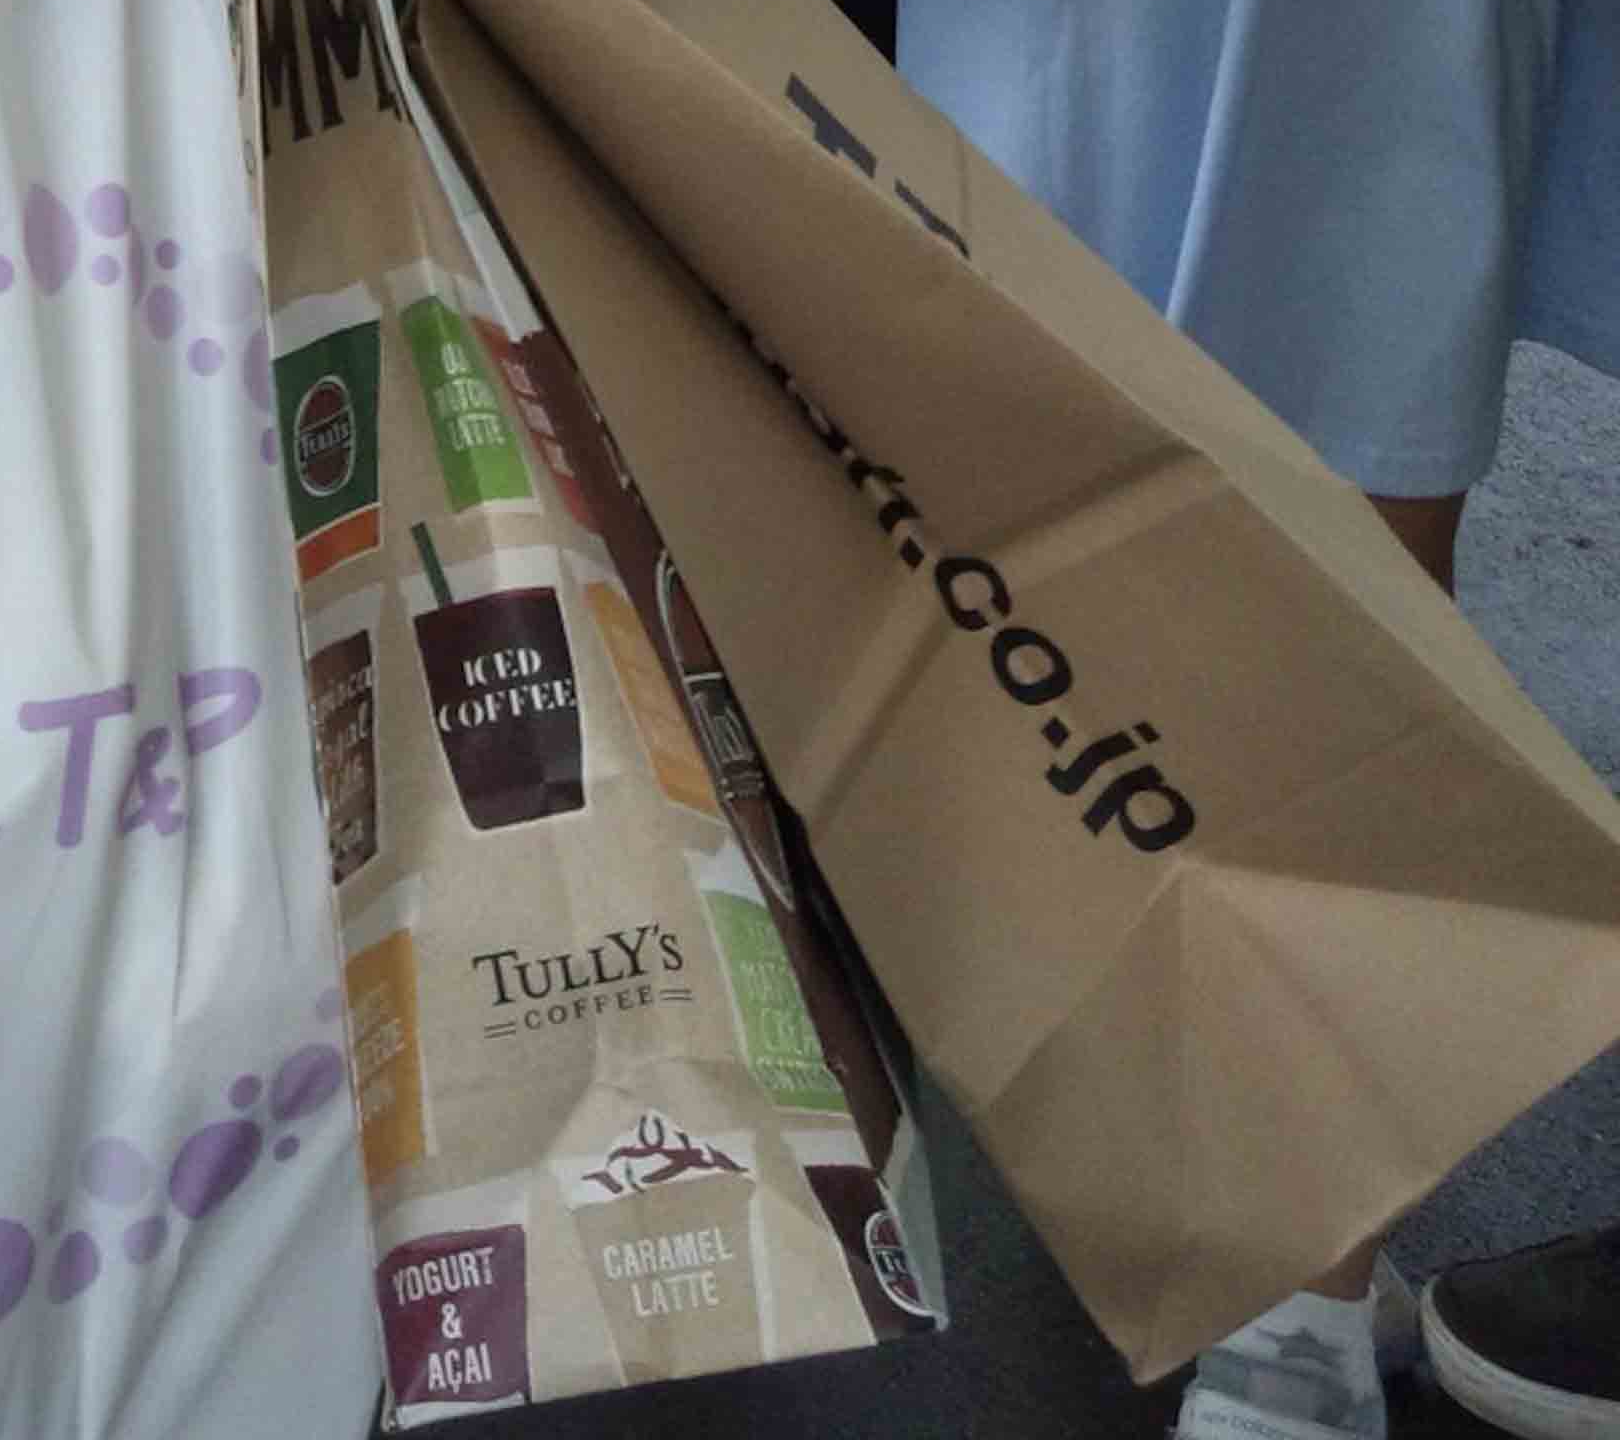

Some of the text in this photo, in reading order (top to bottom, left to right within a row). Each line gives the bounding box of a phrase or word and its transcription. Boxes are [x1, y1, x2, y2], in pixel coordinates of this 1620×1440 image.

[463, 646, 542, 686] ICED
[438, 677, 578, 734] COFFEE
[523, 984, 655, 1031] COFFEE
[392, 1246, 496, 1307] YOGURT
[602, 1226, 734, 1282] CARAMEL
[630, 1270, 720, 1318] LATTE
[440, 1301, 464, 1339] &
[426, 1341, 493, 1395] AÇAI
